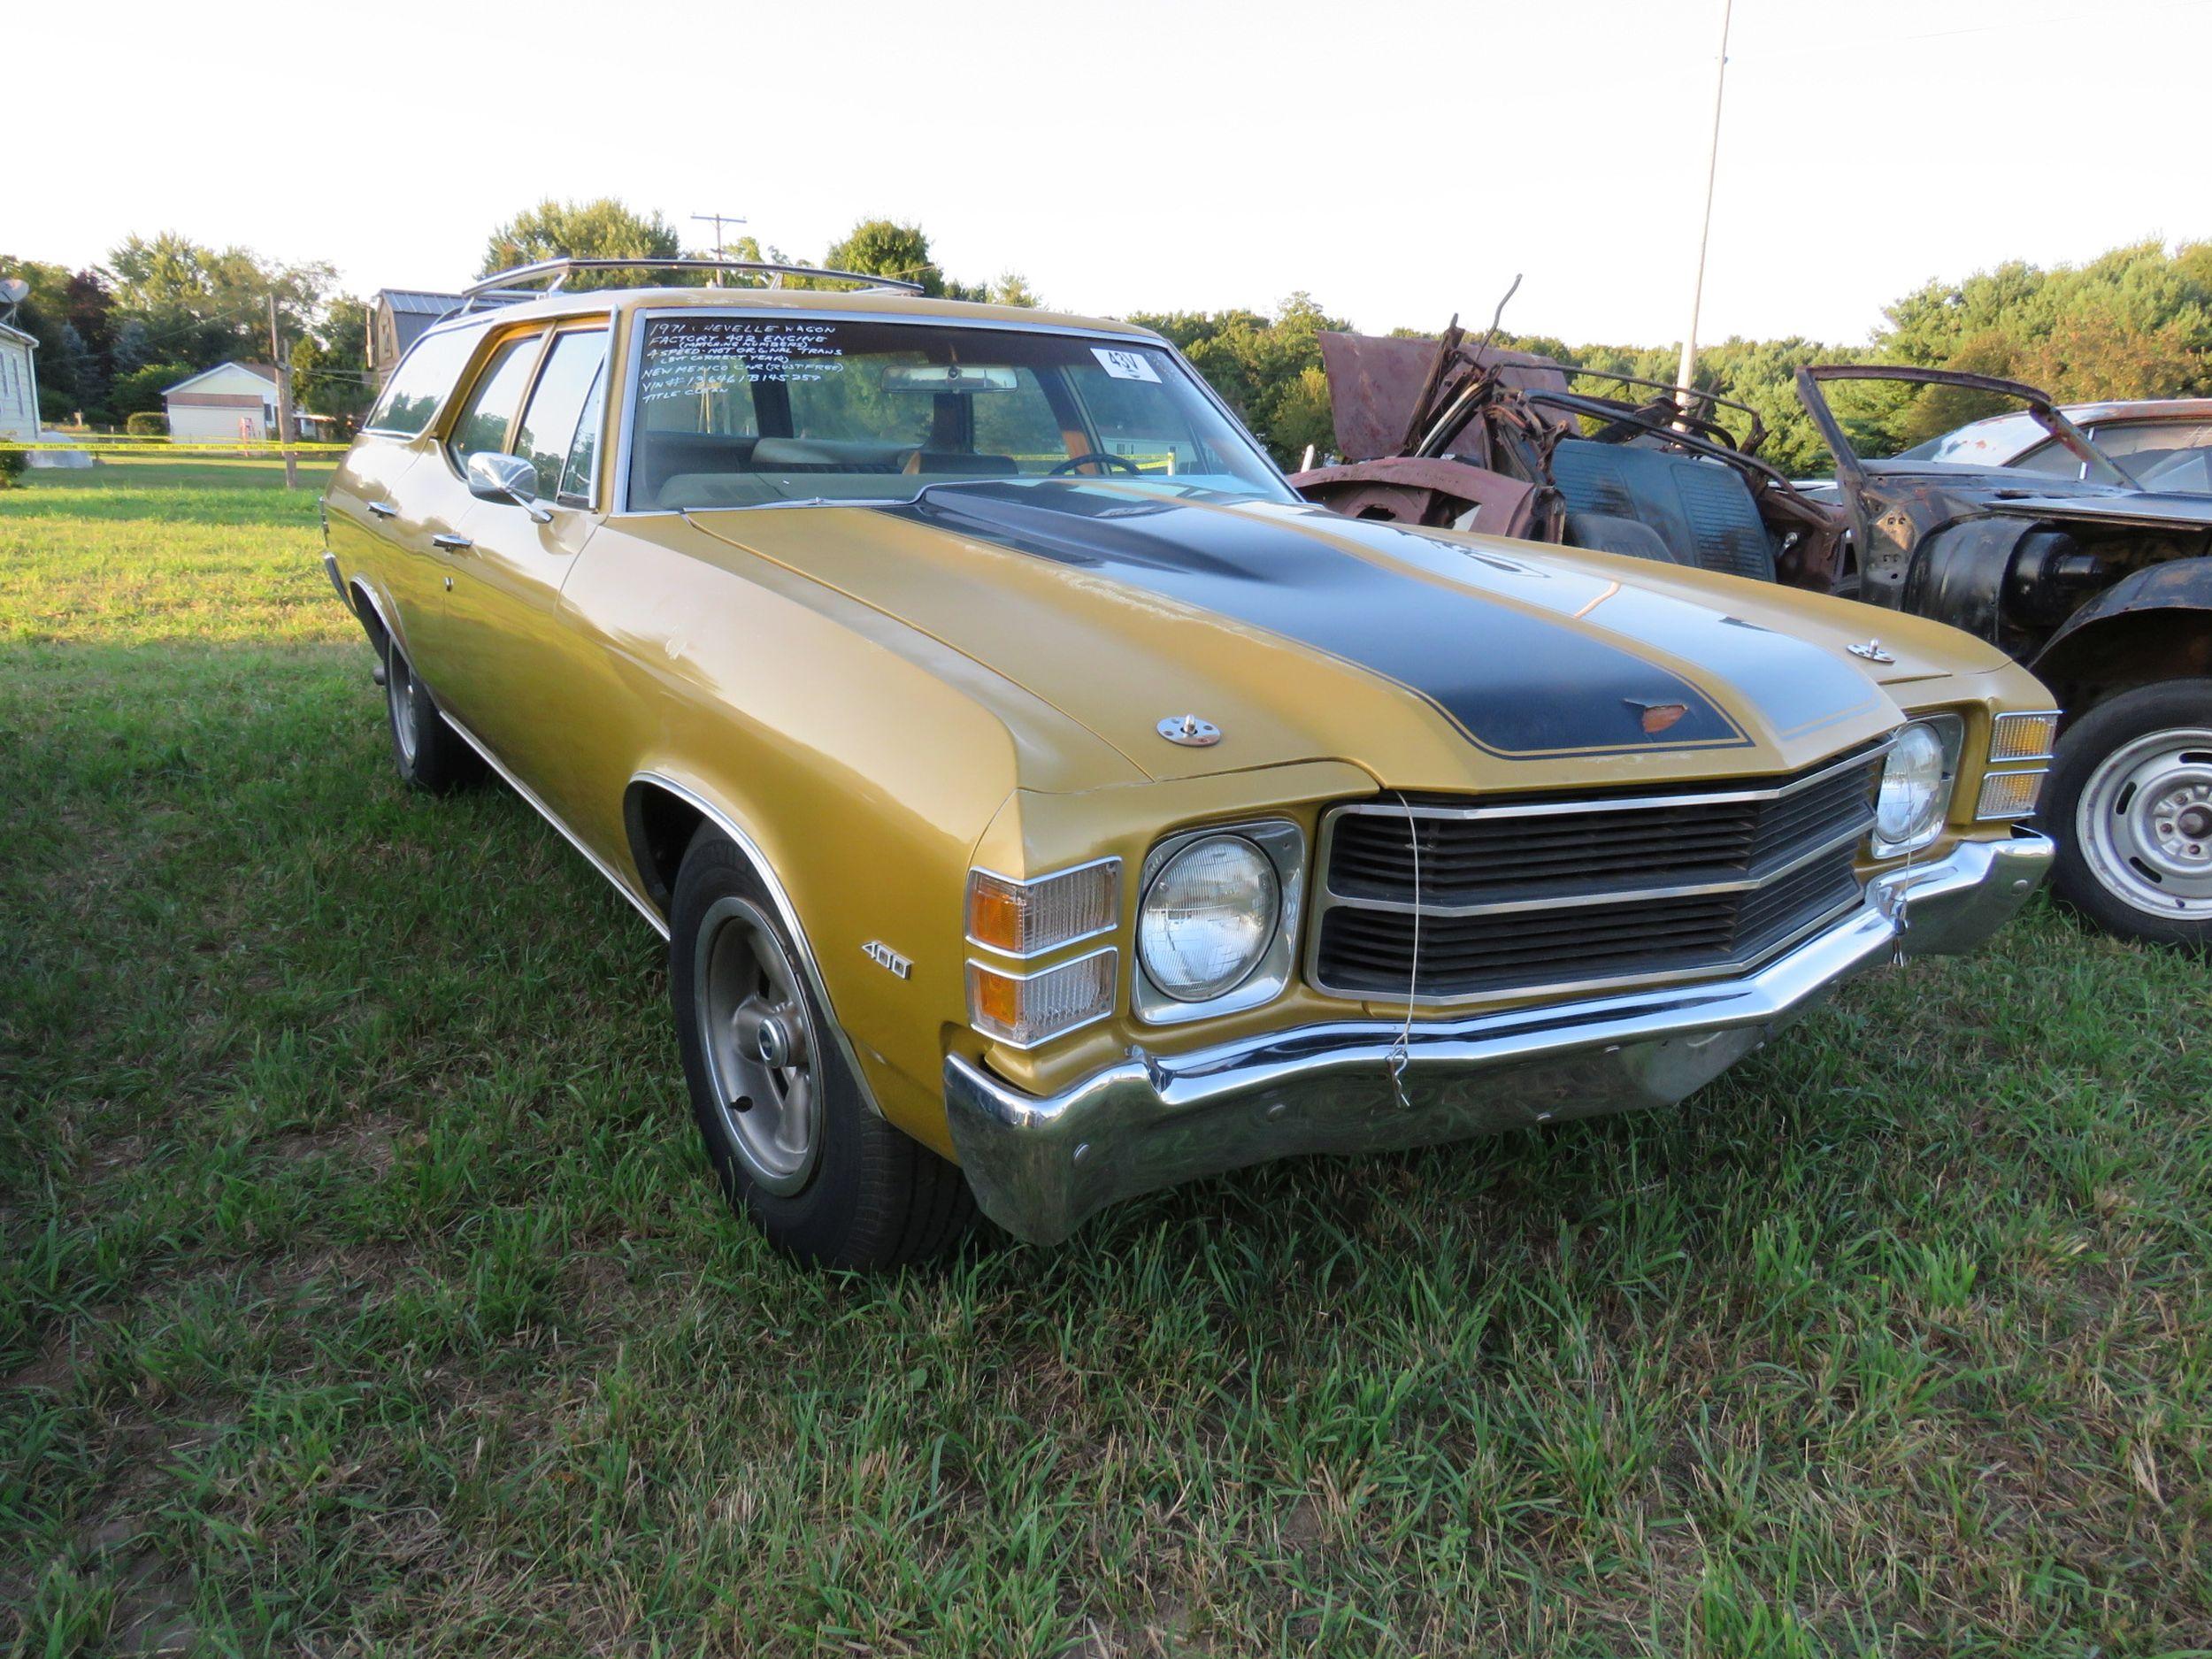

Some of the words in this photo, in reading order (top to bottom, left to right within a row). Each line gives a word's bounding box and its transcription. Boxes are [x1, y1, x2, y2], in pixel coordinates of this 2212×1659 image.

[649, 324, 686, 336] 1971
[649, 334, 718, 346] FACTORY
[647, 349, 657, 359] 4
[641, 367, 672, 380] NEW
[642, 381, 664, 392] VIN
[642, 390, 680, 403] TITLE
[861, 940, 913, 979] 400
